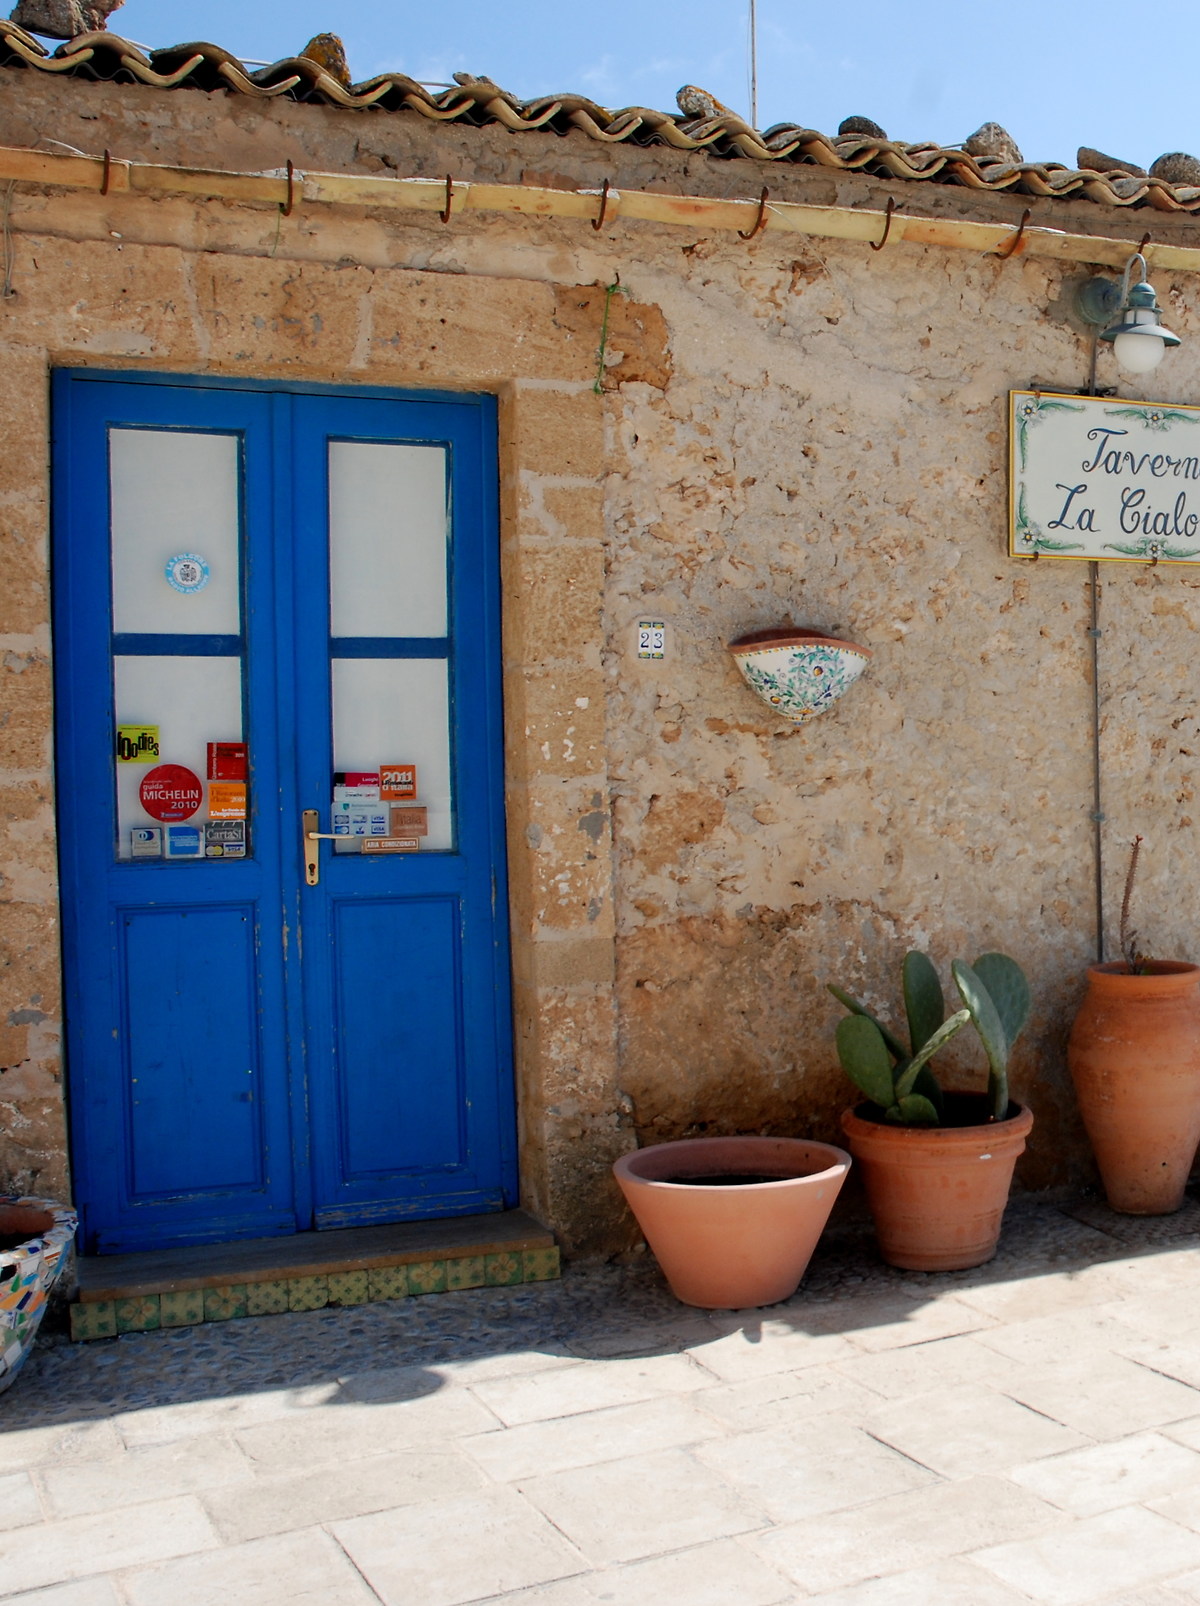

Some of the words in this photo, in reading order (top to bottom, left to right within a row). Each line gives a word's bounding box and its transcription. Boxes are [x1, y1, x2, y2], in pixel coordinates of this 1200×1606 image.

[1047, 483, 1101, 532] La
[640, 631, 663, 649] 23
[117, 732, 159, 760] foodies
[383, 771, 413, 782] 2011
[143, 783, 164, 791] guida
[143, 790, 199, 800] MICHELIN
[171, 801, 198, 809] 2010
